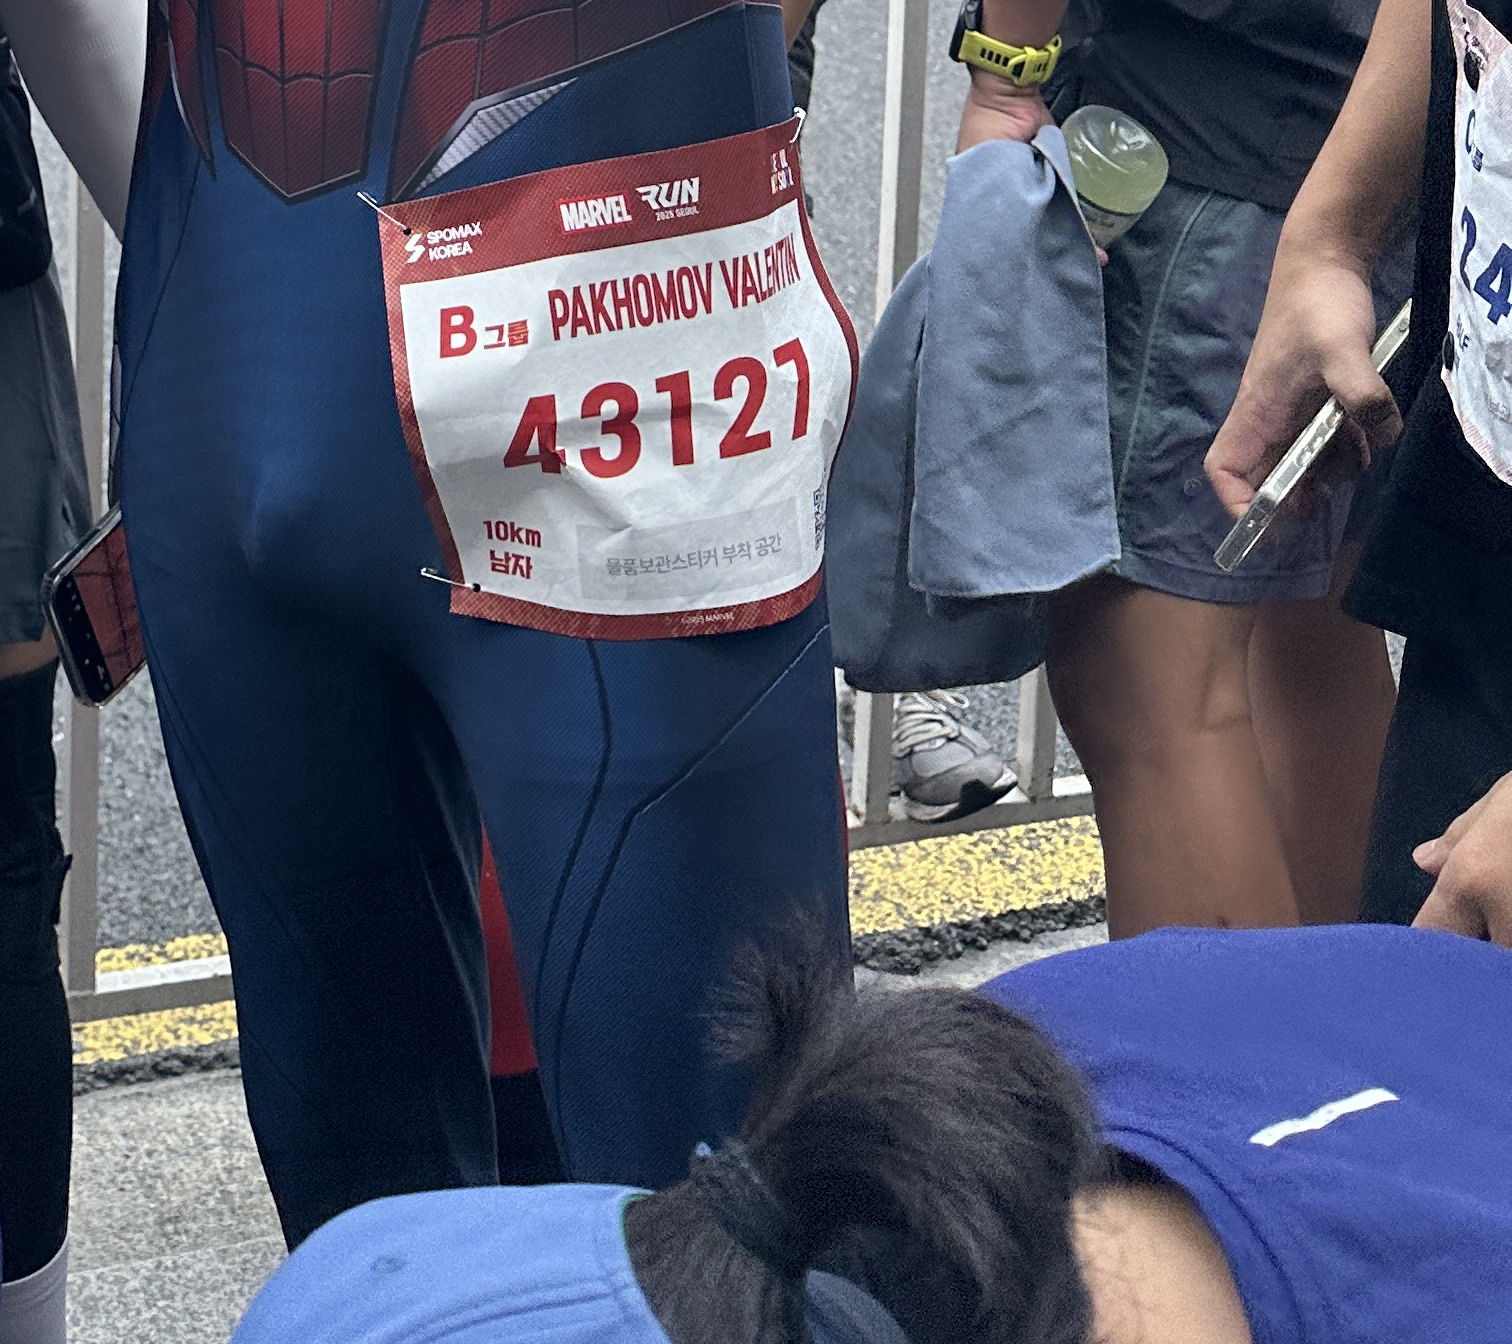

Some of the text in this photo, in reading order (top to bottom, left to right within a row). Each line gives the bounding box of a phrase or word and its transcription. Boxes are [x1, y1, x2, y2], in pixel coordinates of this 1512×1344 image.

[558, 177, 700, 233] MARVEL RUN
[427, 221, 482, 244] SPOMAX
[429, 240, 473, 261] KOREA
[548, 232, 801, 341] PAKHOMOV VALENTIN
[504, 337, 810, 479] 43127
[483, 520, 542, 548] 10km
[489, 549, 533, 579] 남자
[606, 531, 783, 577] 물품보관스티커 부착 공간
